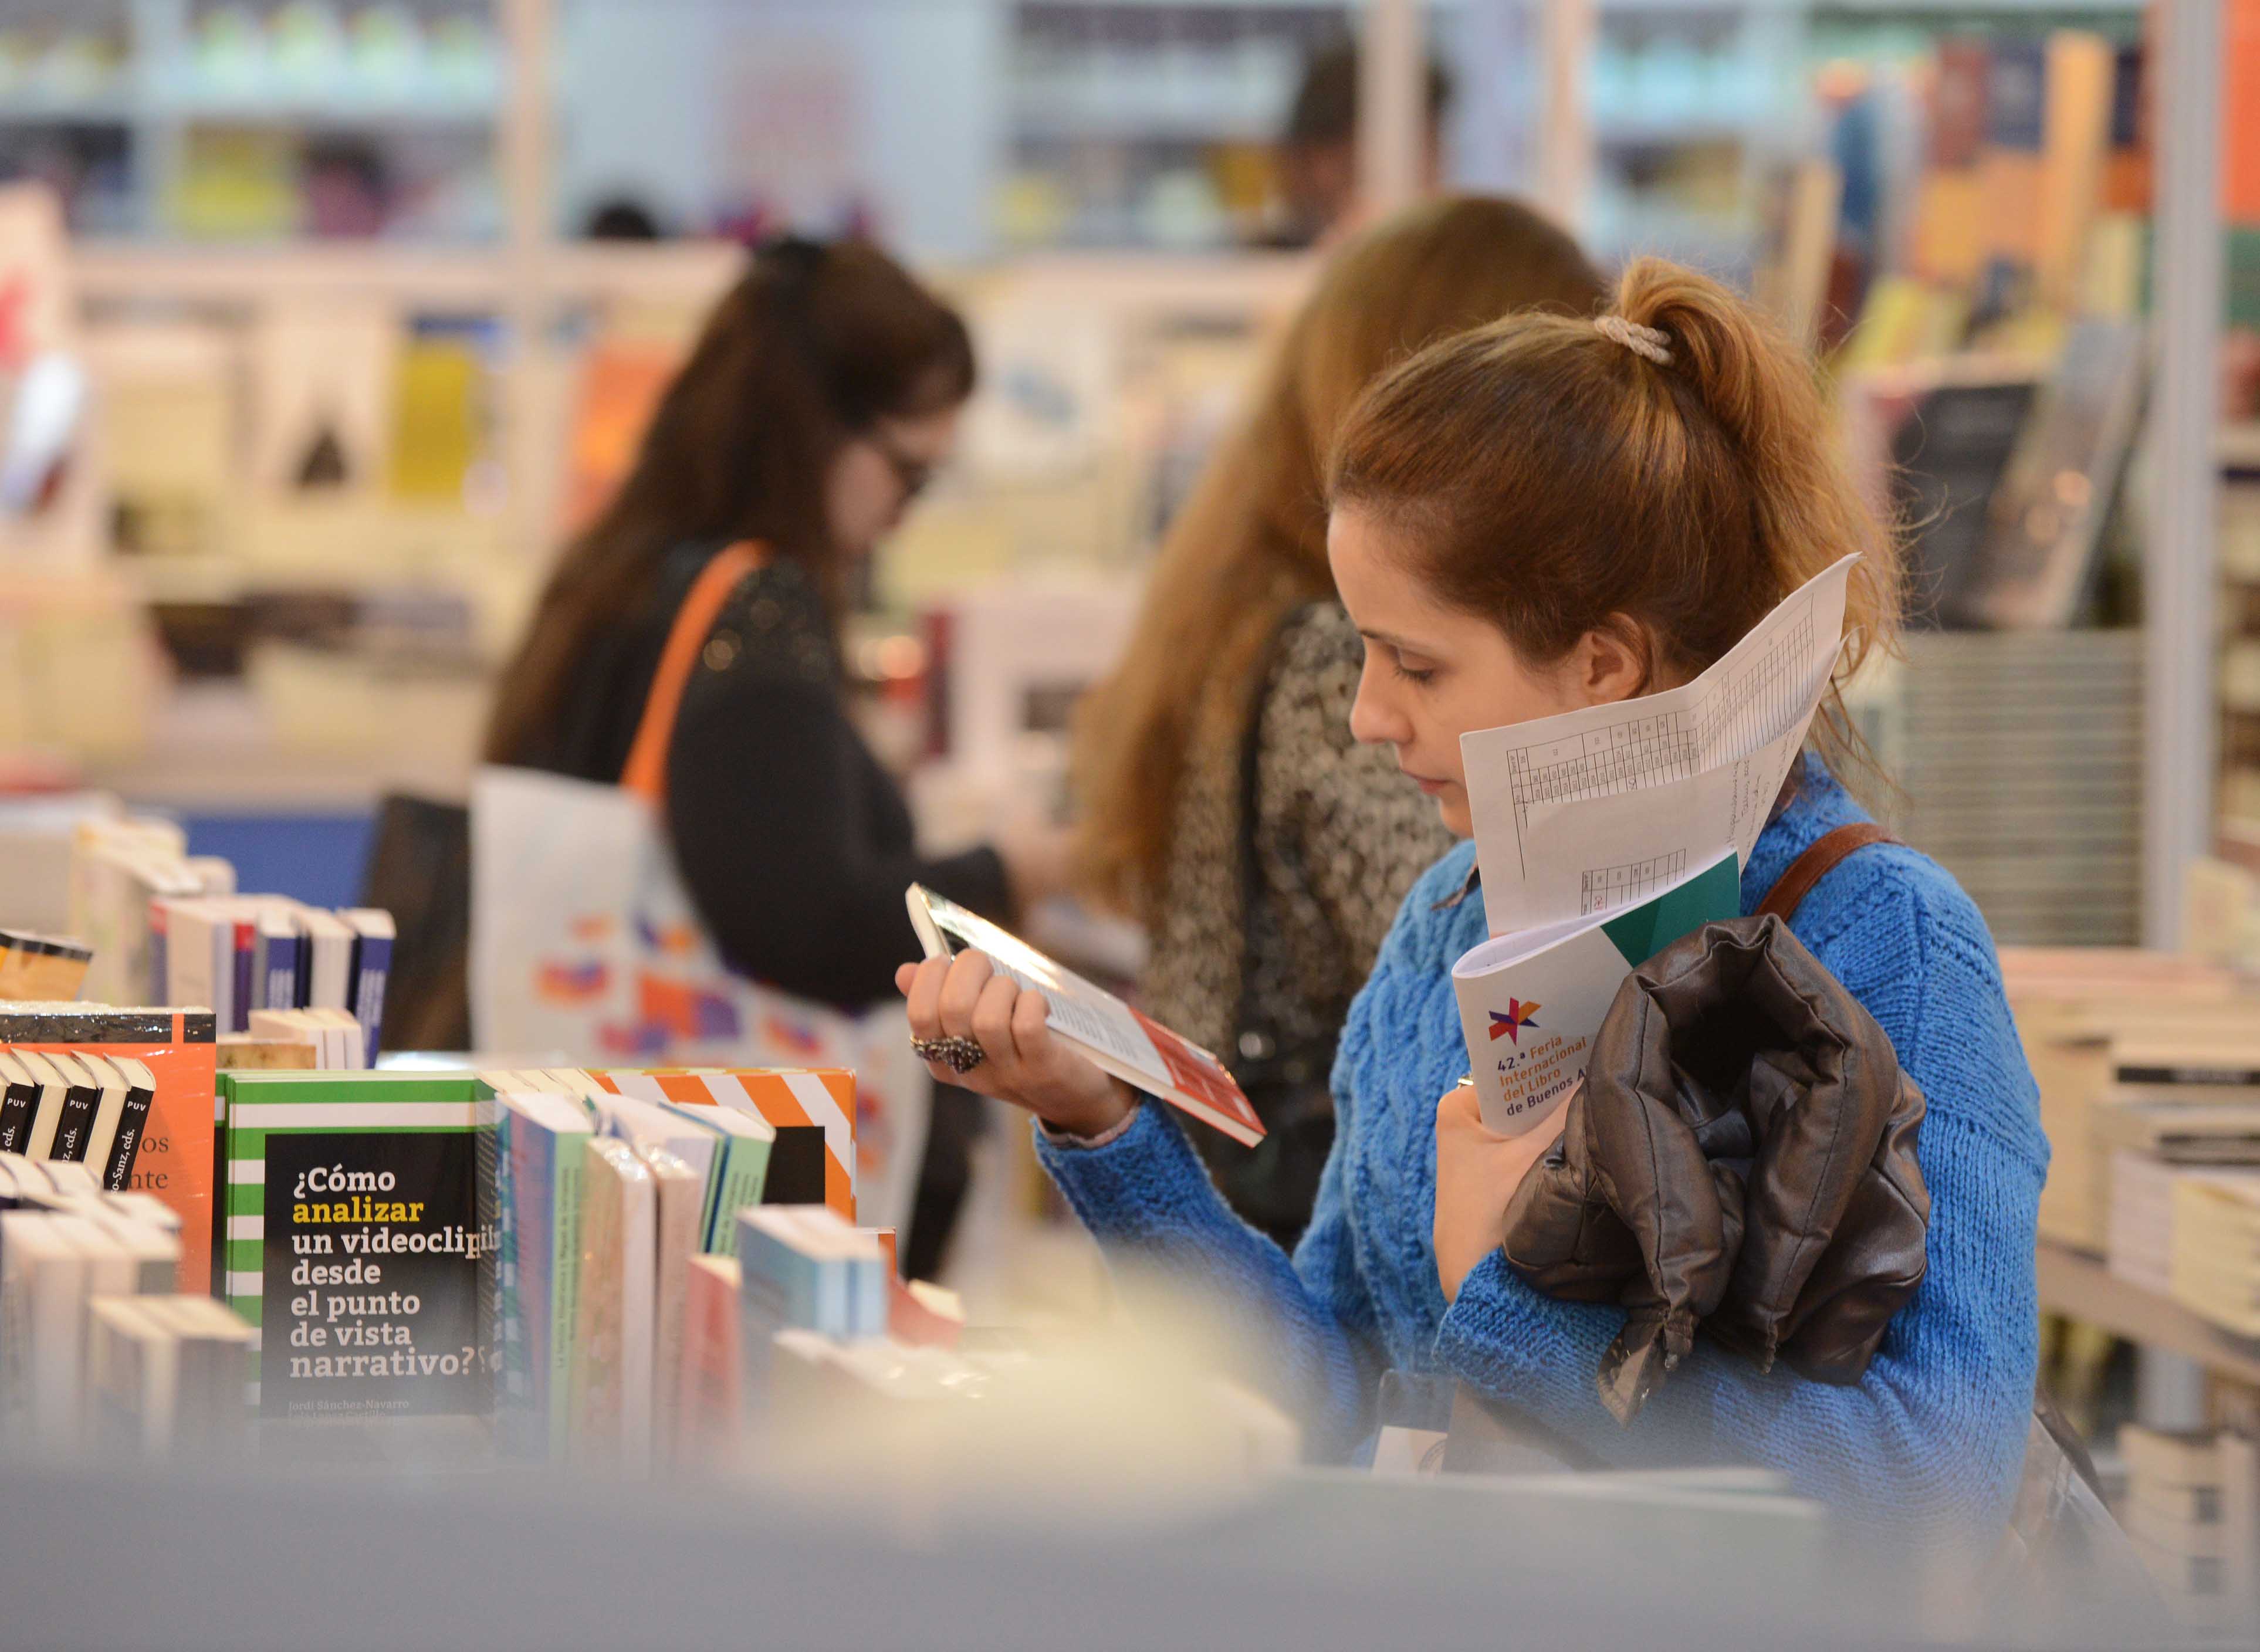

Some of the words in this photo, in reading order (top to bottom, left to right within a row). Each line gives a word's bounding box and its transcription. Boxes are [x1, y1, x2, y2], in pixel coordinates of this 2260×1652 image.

[1530, 1036, 1562, 1059] Feria
[1499, 1036, 1586, 1087] Internacional
[1504, 1085, 1524, 1102] del
[1528, 1068, 1561, 1092] Libro
[1507, 1103, 1523, 1116] de
[1527, 1077, 1573, 1108] Buenos
[7, 1098, 26, 1108] PUV
[69, 1099, 88, 1110] PUV
[127, 1101, 146, 1112] PUV
[2, 1126, 15, 1146] eds.
[65, 1128, 77, 1148] eds.
[121, 1129, 135, 1150] eds.
[293, 1163, 395, 1199] ¿Cómo
[293, 1196, 424, 1223] analizar
[292, 1234, 333, 1254] un
[340, 1226, 481, 1259] videoclip
[291, 1258, 381, 1285] desde
[290, 1289, 319, 1316] el
[327, 1291, 420, 1322] punto
[290, 1321, 327, 1346] de
[334, 1319, 412, 1346] vista
[290, 1347, 475, 1378] narrativo?
